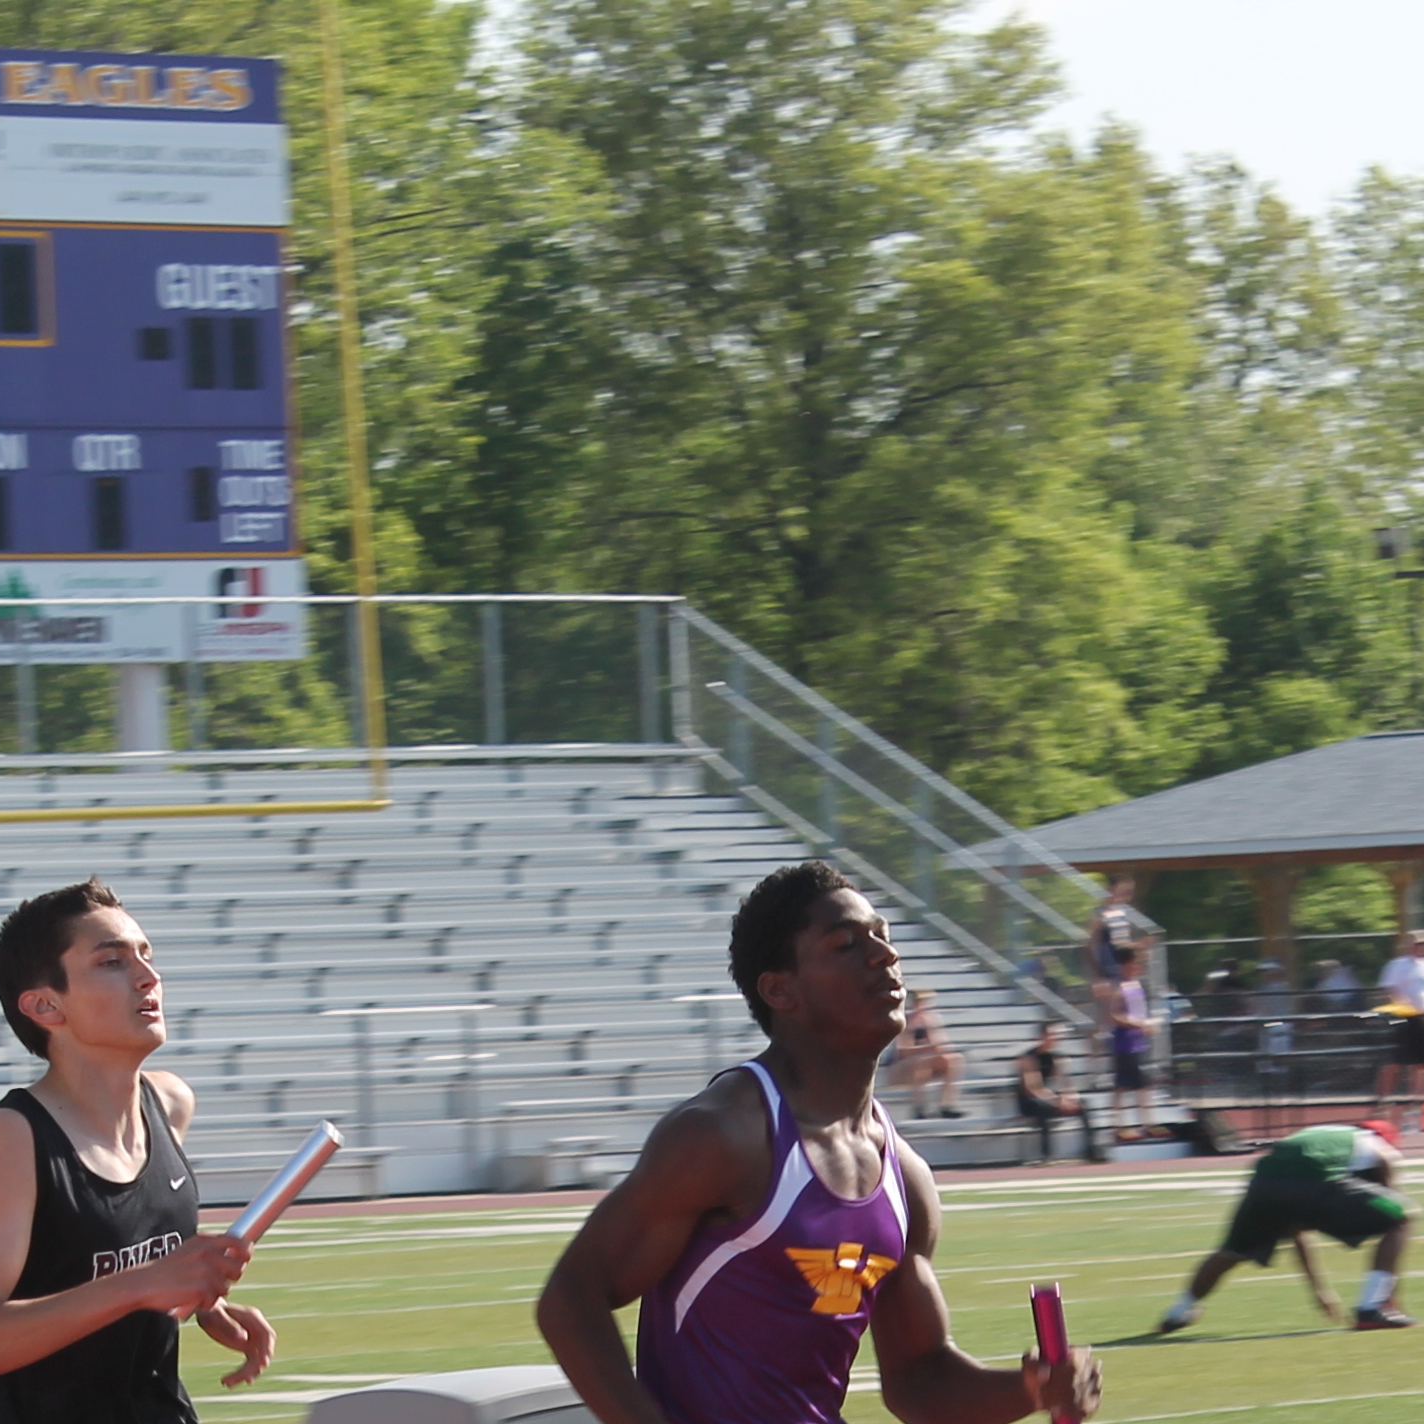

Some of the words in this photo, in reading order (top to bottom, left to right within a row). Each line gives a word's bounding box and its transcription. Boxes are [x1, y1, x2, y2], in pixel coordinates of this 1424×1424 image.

[0, 61, 254, 112] EAGLES
[156, 262, 282, 310] GUEST
[72, 432, 143, 471] QTR
[217, 438, 285, 470] TIME
[218, 511, 286, 543] LEFT
